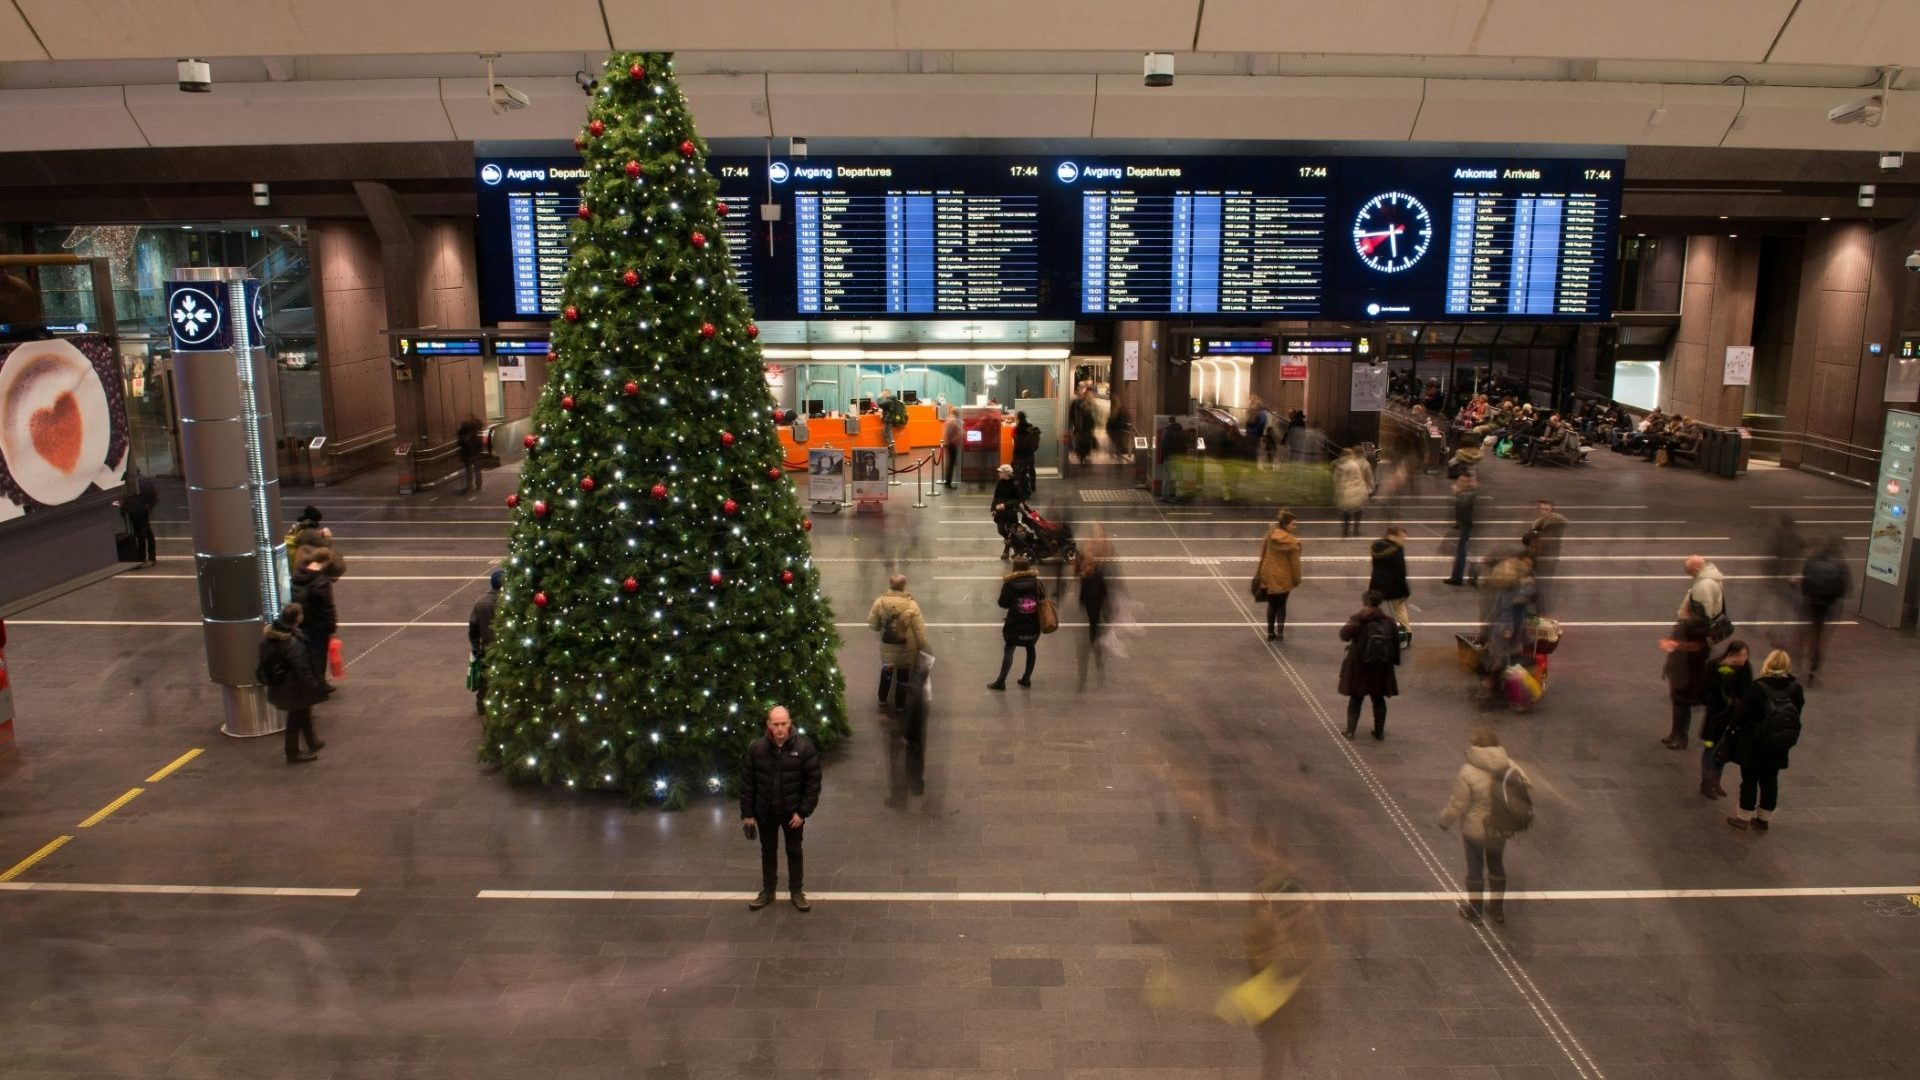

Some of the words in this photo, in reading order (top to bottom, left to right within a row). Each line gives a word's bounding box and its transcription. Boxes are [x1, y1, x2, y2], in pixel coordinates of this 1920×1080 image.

[507, 168, 544, 180] Avgang
[549, 168, 590, 180] Departur
[722, 166, 749, 178] 17:44
[794, 166, 832, 180] Avgang
[837, 167, 892, 178] Departures
[1010, 166, 1038, 176] 17:44
[1083, 167, 1122, 179] Avgang
[1126, 168, 1182, 178] Departures
[1299, 167, 1327, 177] 17:44
[1454, 168, 1497, 179] Ankomst
[1503, 168, 1540, 179] Arrivals
[1584, 170, 1612, 180] 17:44
[402, 346, 409, 354] 7
[1194, 345, 1200, 353] 9
[1359, 345, 1369, 354] 10
